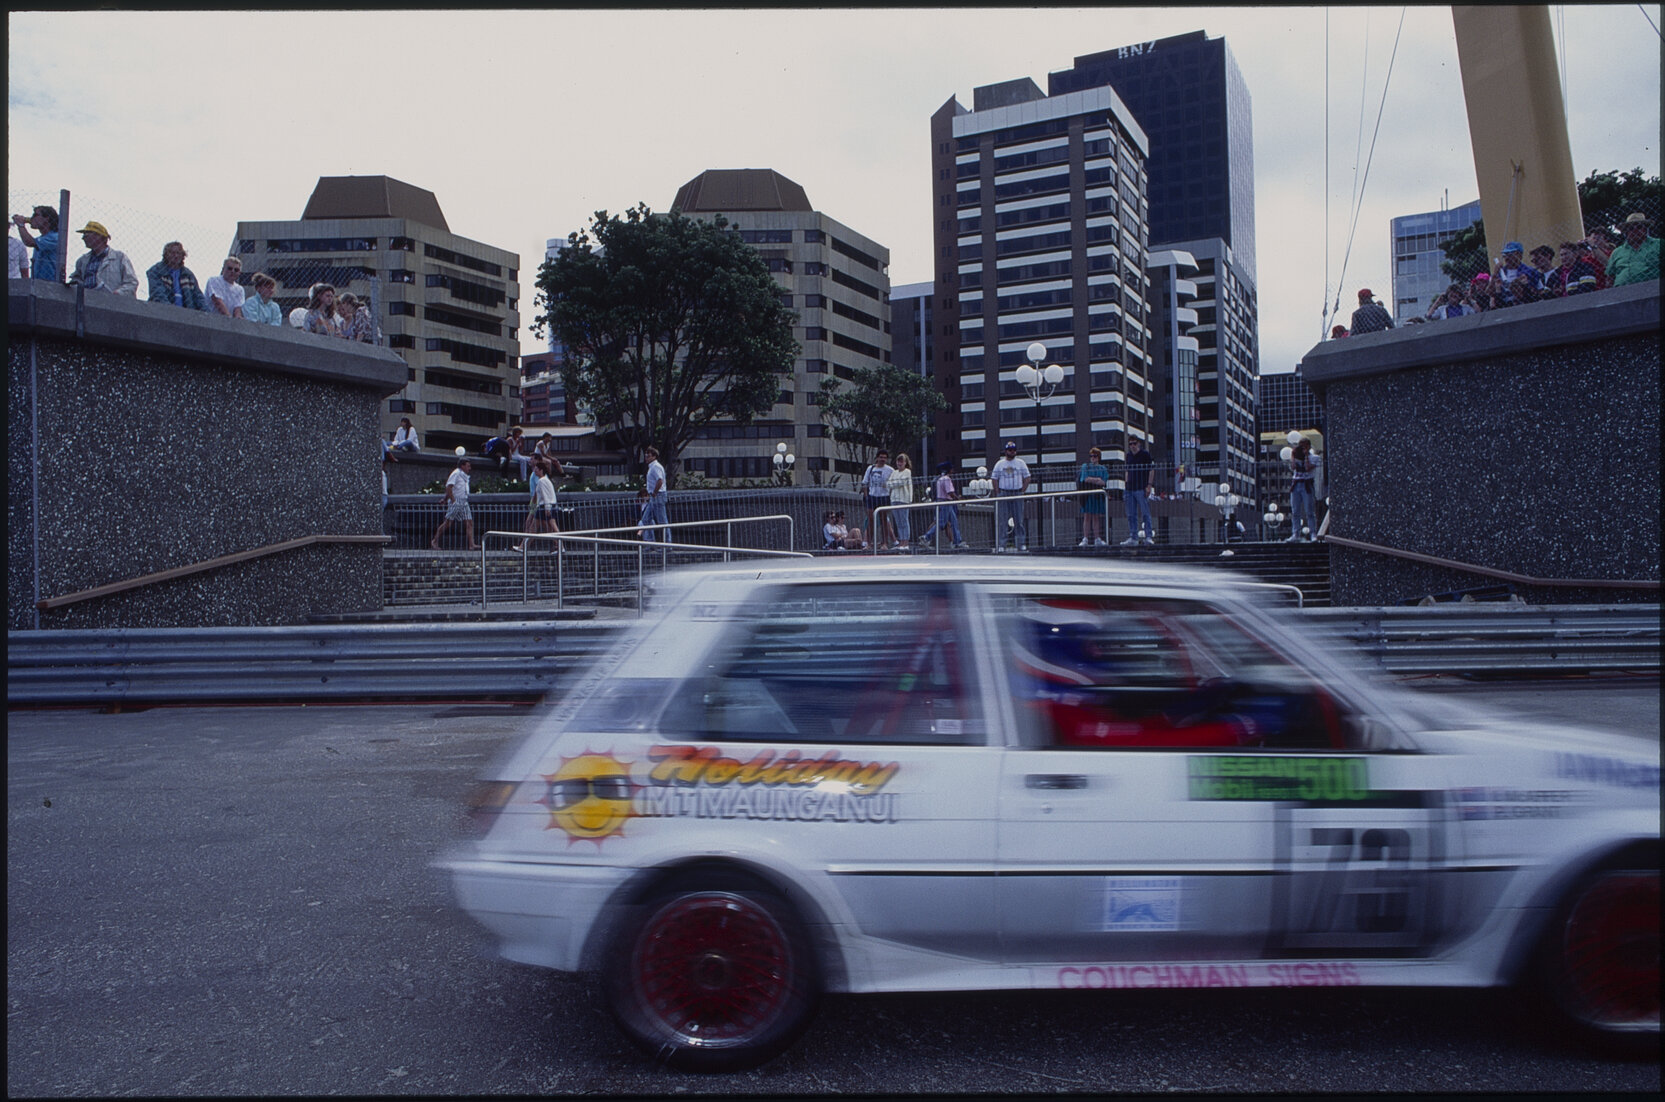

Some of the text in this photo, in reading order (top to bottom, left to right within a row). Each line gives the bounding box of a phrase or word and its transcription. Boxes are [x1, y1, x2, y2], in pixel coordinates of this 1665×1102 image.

[647, 745, 899, 797] Holiday
[1297, 758, 1367, 800] 500
[696, 787, 899, 824] MAUNGANUI
[1058, 962, 1361, 989] COUCHMAN SIGNS
